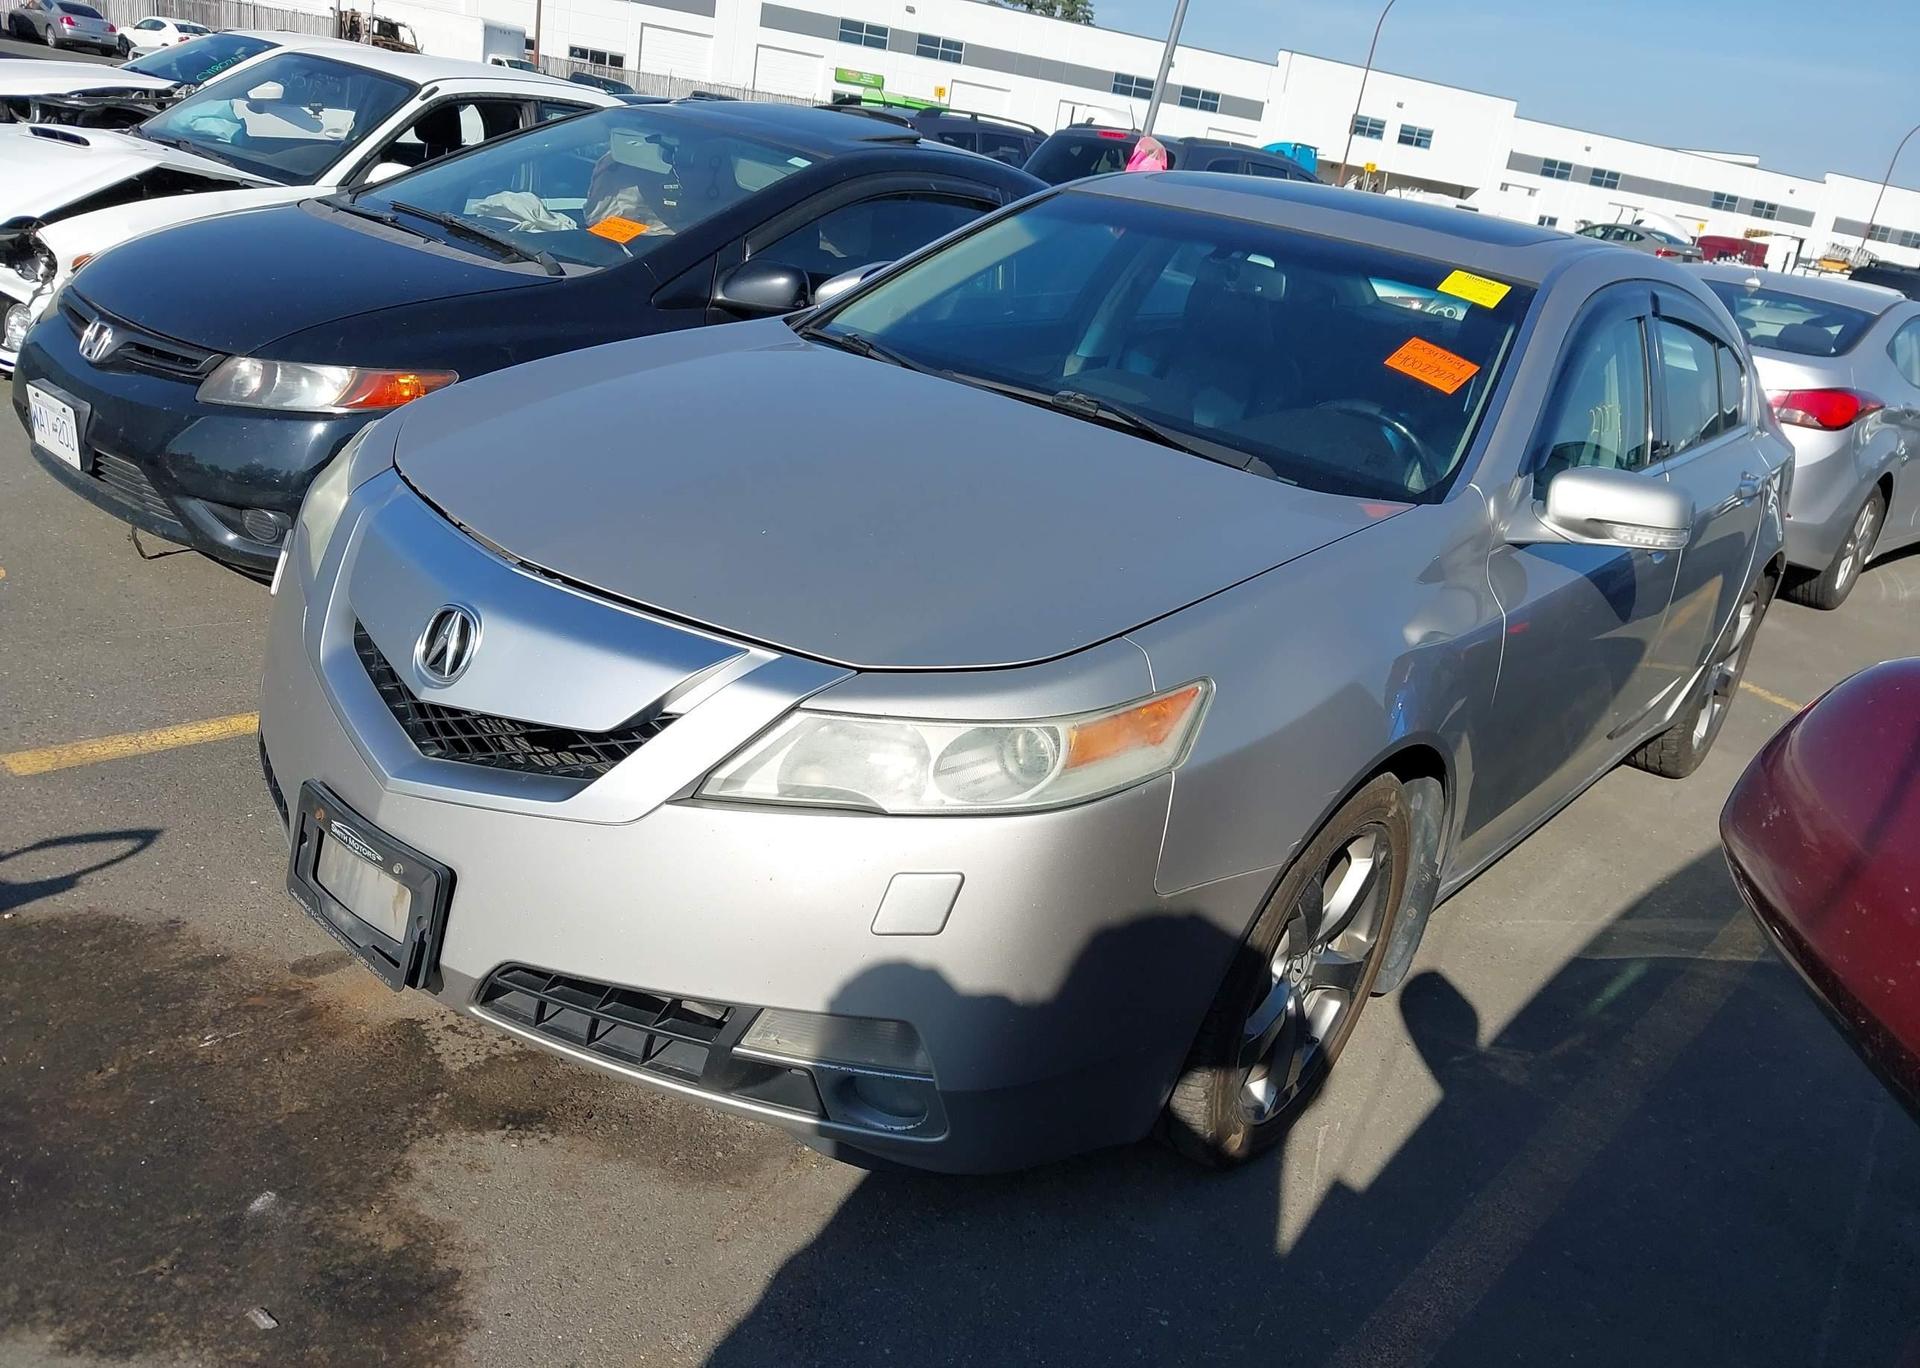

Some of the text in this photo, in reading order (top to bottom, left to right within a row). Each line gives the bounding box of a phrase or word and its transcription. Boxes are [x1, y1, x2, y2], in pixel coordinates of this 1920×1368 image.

[56, 416, 75, 452] 20J
[331, 823, 348, 844] SMITH
[348, 836, 377, 861] MOTORS
[356, 952, 369, 967] USED
[368, 962, 392, 986] VEHICLES
